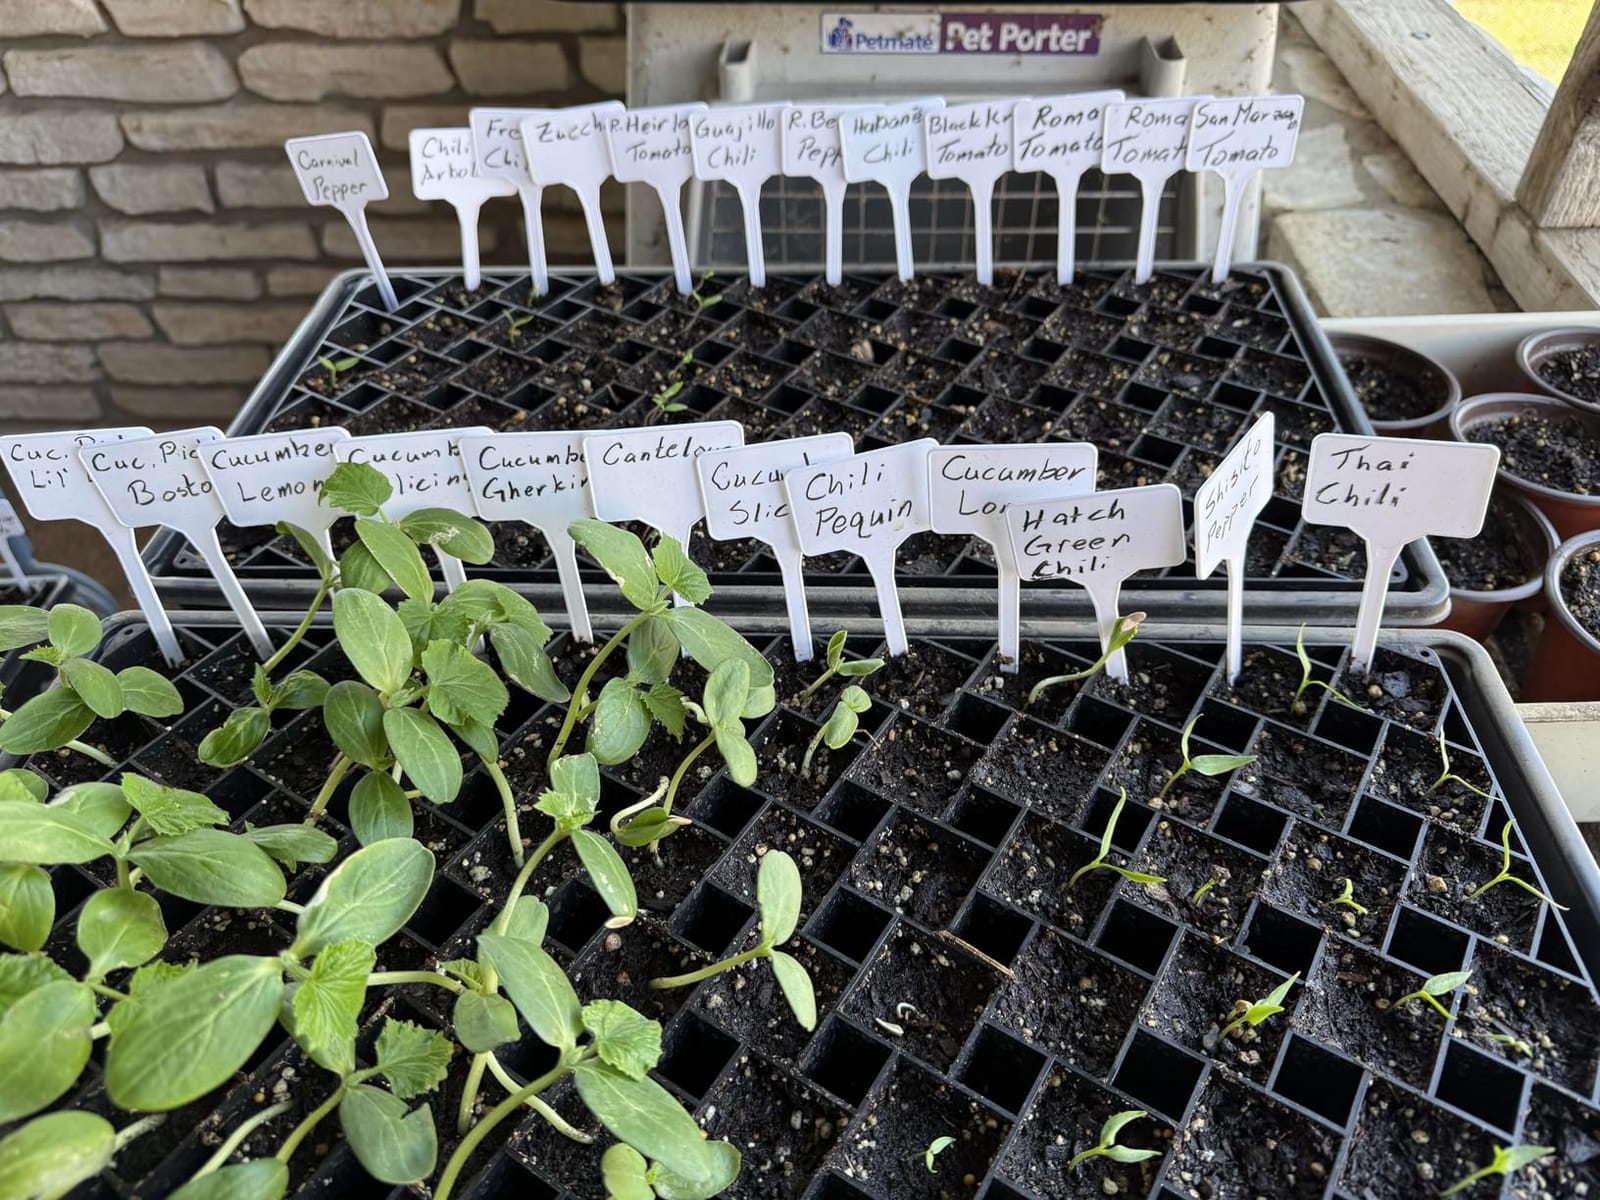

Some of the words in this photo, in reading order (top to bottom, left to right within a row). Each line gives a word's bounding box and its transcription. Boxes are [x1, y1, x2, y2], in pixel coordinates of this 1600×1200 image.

[855, 32, 933, 49] Petmate
[946, 22, 993, 51] Pet
[1001, 23, 1092, 52] Porter
[1032, 105, 1099, 131] Roma
[1125, 105, 1188, 129] Roma
[1196, 103, 1228, 129] San
[298, 149, 360, 170] Carnival
[422, 136, 469, 158] Chili
[708, 147, 756, 168] Chili
[863, 138, 912, 164] Chili
[937, 134, 1009, 164] Tomato
[1197, 130, 1279, 167] Tomato
[421, 160, 478, 186] Arbol
[313, 177, 367, 200] Pepper
[159, 439, 203, 463] Pic
[603, 436, 731, 465] Cantelo
[1331, 444, 1415, 471] Thai
[805, 462, 885, 500] Chili
[942, 455, 1086, 481] Cucumber
[398, 472, 471, 495] licin
[1315, 482, 1407, 508] Chili
[815, 499, 912, 538] Pequin
[1023, 499, 1125, 533] Hatch
[1024, 533, 1130, 556] Green
[1031, 556, 1110, 581] Chili
